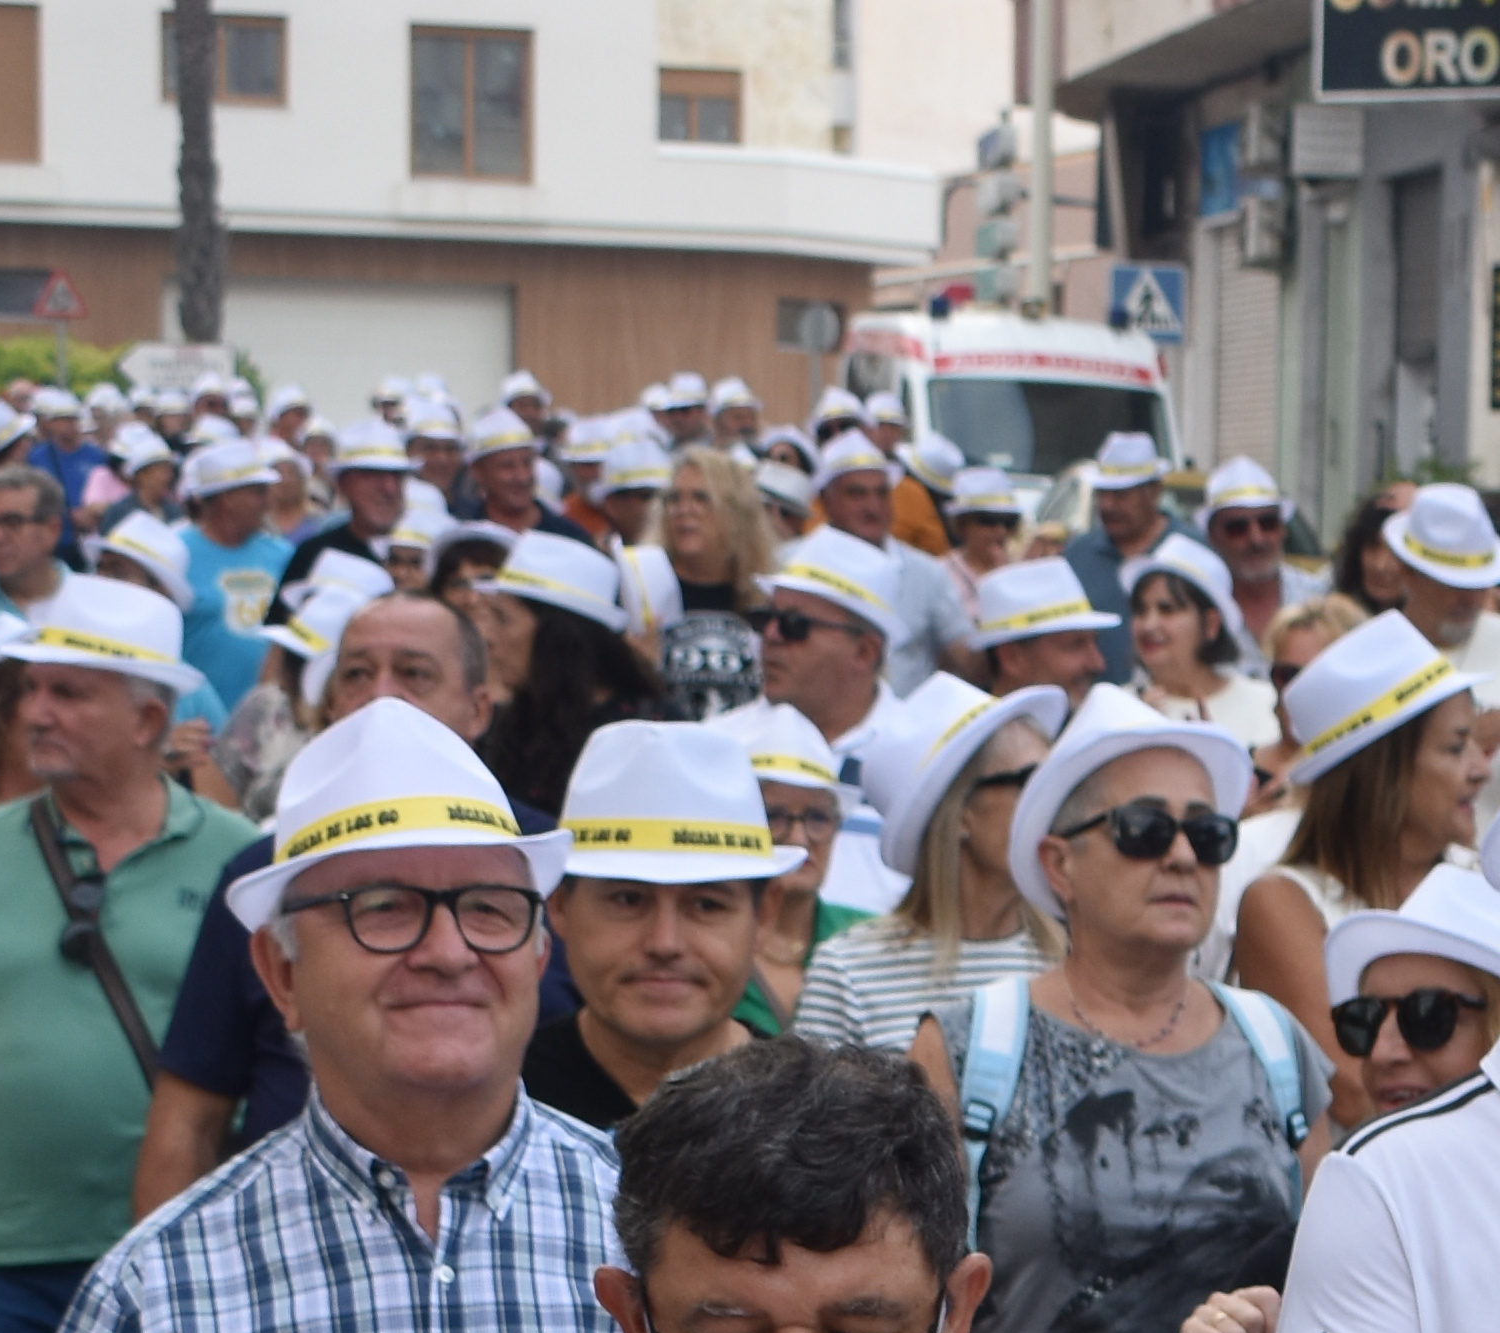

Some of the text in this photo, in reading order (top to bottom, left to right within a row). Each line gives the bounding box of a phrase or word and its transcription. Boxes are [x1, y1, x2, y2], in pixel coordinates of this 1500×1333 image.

[1380, 26, 1500, 86] ORO
[326, 821, 343, 841] DE
[345, 813, 373, 833] LOS
[446, 803, 496, 827] DÉCADA
[671, 826, 721, 847] DÉCADA
